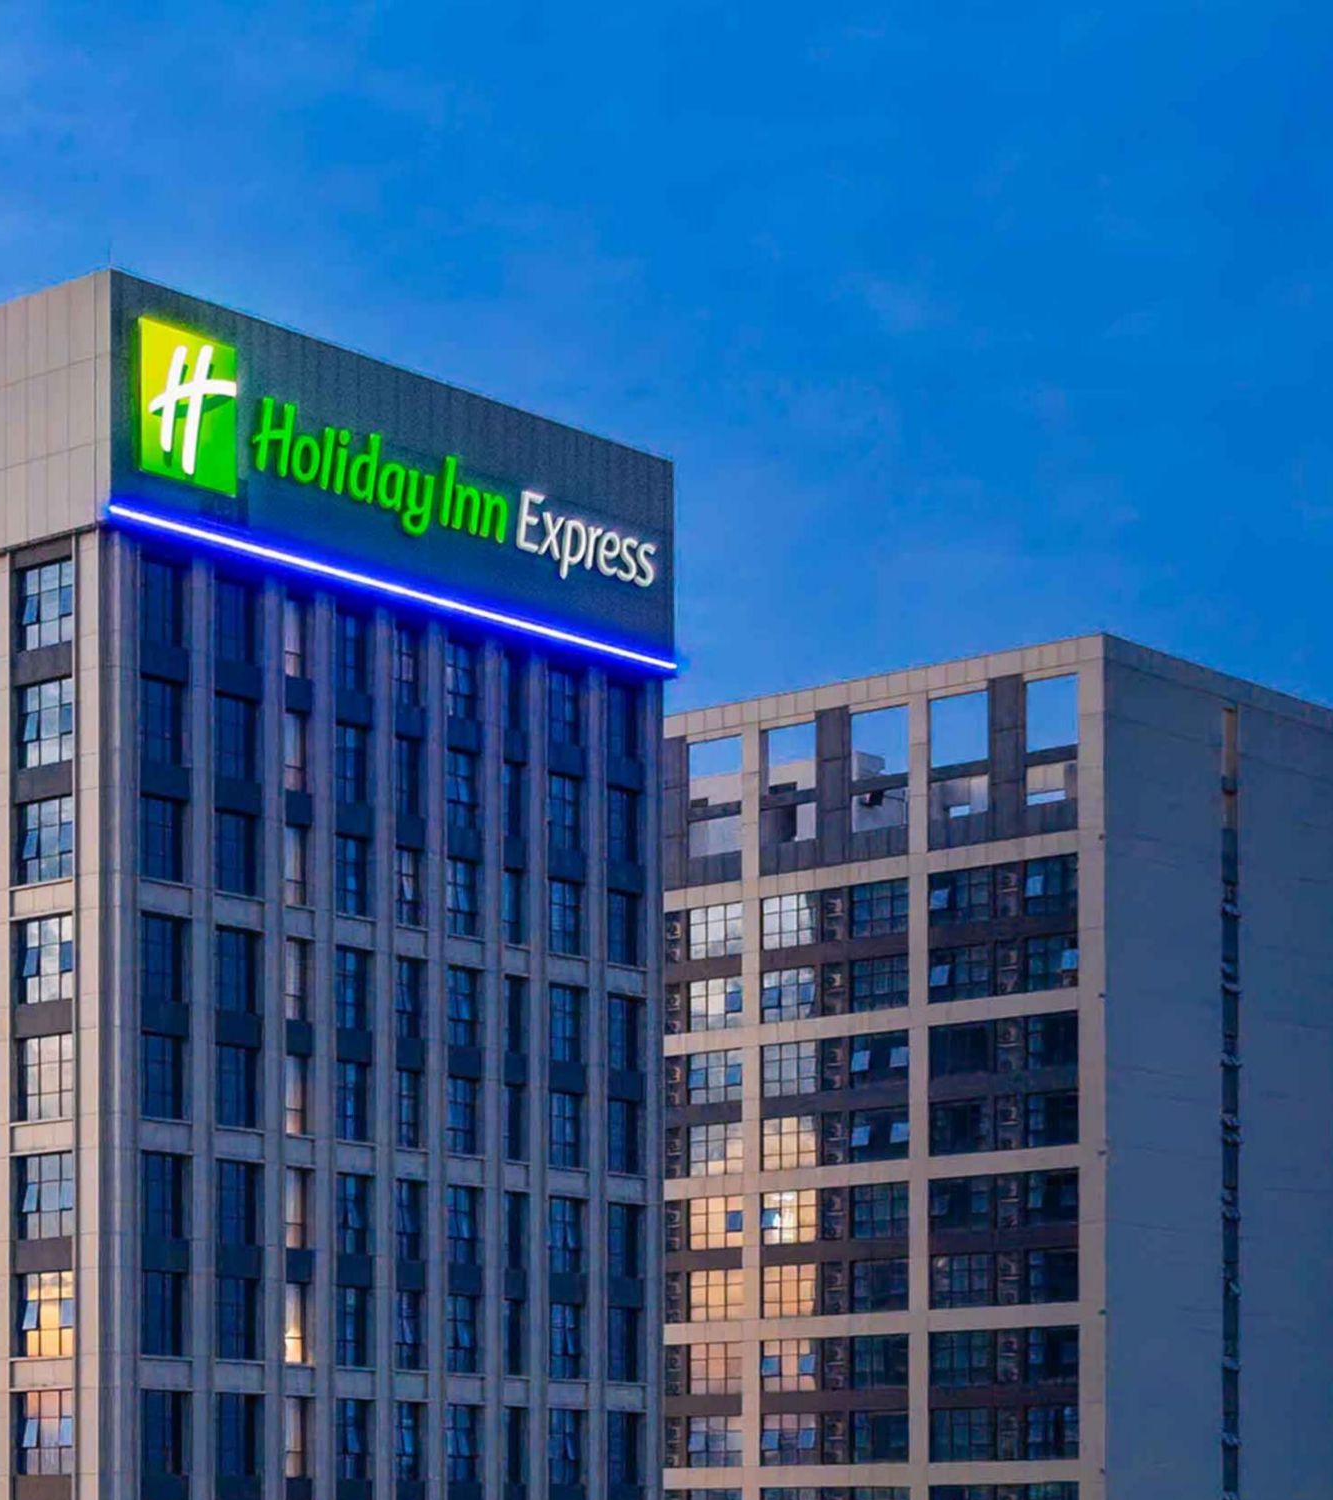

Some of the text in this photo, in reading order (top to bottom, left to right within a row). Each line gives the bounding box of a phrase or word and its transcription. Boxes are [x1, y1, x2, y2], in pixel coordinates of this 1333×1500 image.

[252, 396, 658, 588] Holiday Inn Express
